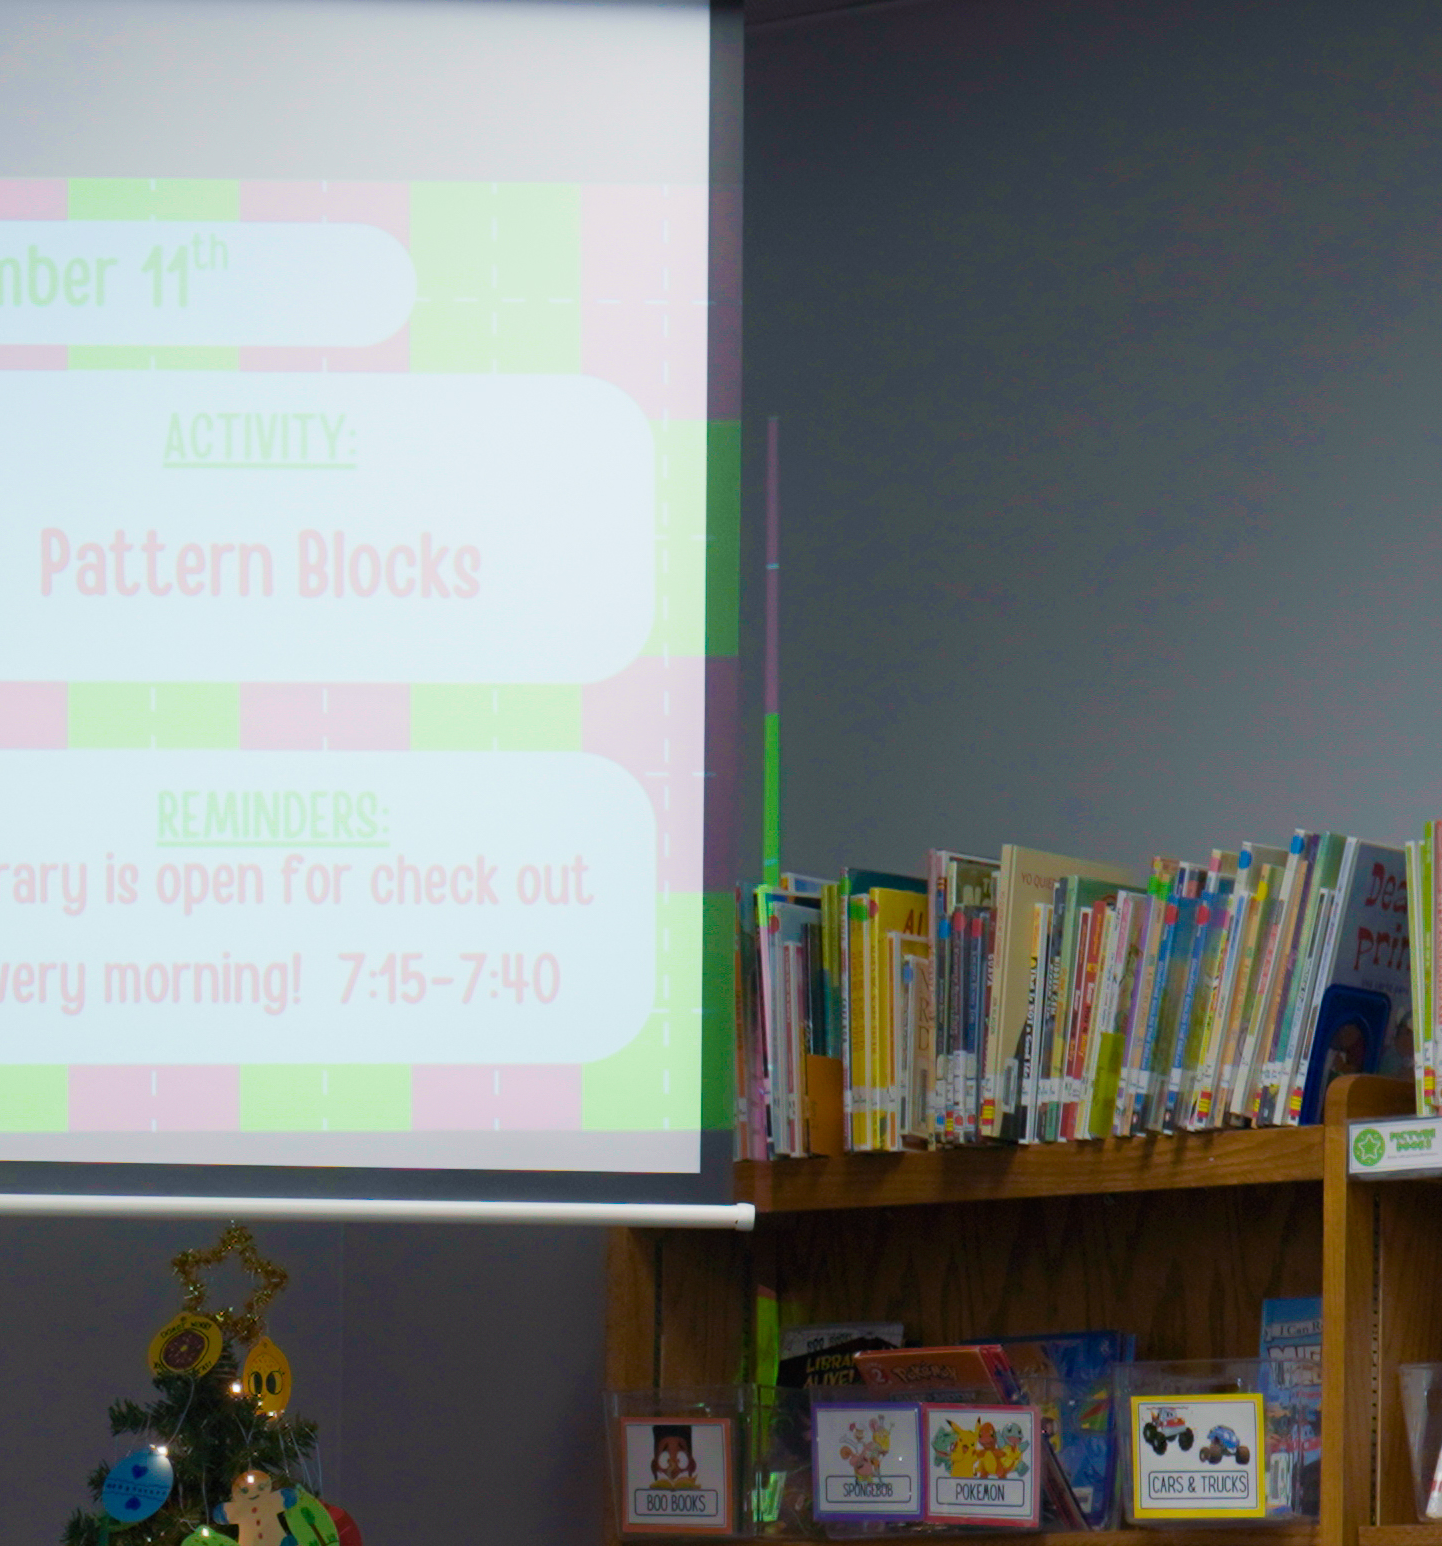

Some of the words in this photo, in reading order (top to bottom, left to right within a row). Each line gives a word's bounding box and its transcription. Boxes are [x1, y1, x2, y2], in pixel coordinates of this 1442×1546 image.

[141, 233, 228, 308] 11th
[163, 411, 359, 464] ACTIVITY:
[40, 527, 274, 598] Pattern
[298, 529, 482, 600] Blocks
[157, 790, 390, 843] REMINDERS:
[106, 852, 139, 906] is
[156, 863, 264, 916] open
[282, 854, 353, 906] for
[371, 855, 499, 906] check
[516, 857, 595, 906] out
[103, 952, 303, 1016] morning!
[338, 952, 560, 1005] 7:15-7:40
[646, 1495, 669, 1512] BOO
[671, 1494, 706, 1512] BOOKS
[842, 1481, 894, 1500] SPONGEBOB
[955, 1482, 1006, 1502] POKEMON
[1152, 1475, 1184, 1494] CARS
[1187, 1476, 1196, 1493] &
[1201, 1474, 1248, 1493] TRUCKS
